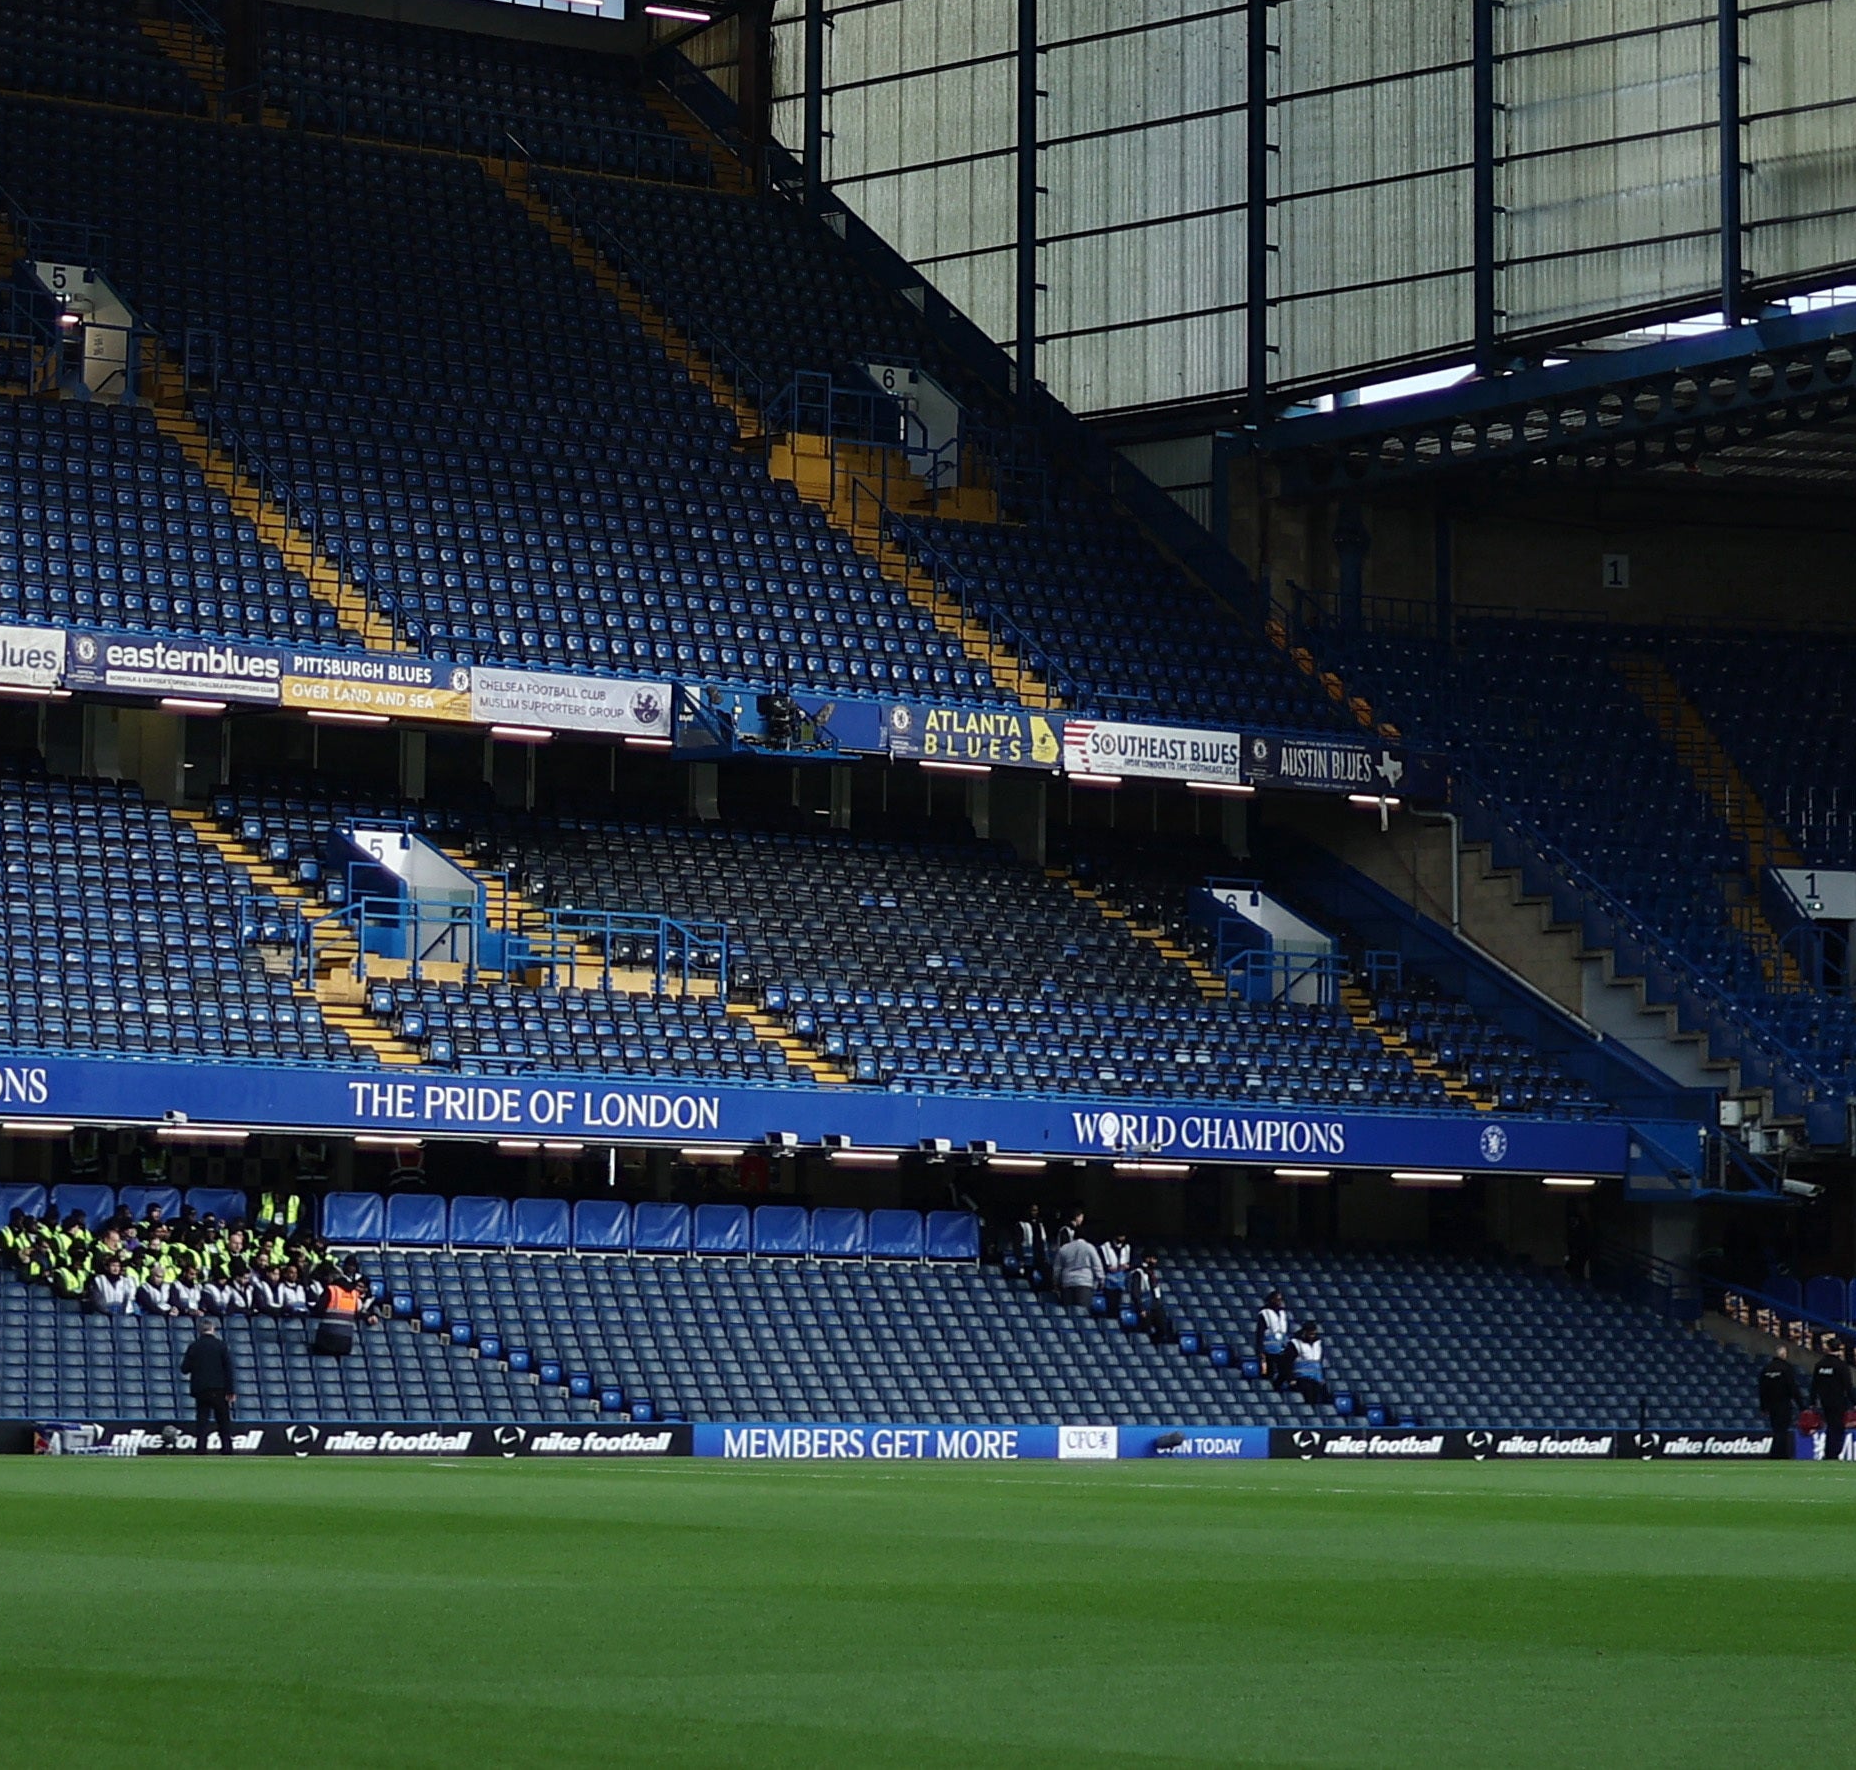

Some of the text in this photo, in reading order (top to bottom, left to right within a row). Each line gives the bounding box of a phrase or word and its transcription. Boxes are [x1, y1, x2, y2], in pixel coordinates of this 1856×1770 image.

[53, 267, 66, 288] 5
[883, 368, 895, 389] 6
[1609, 561, 1623, 585] 1
[106, 641, 280, 678] easternblues
[294, 656, 432, 684] PITTSBURGH BLUES
[292, 683, 329, 700] OVER
[334, 686, 371, 703] LAND
[375, 690, 406, 706] AND
[409, 694, 434, 709] SEA
[479, 679, 607, 700] CHELSEA FOOTBALL CLUB
[479, 696, 519, 709] MUSLIM
[521, 699, 587, 716] SUPPORTERS
[590, 706, 625, 719] GROUP
[925, 709, 1022, 738] ATLANTA
[924, 733, 1022, 762] BLUES
[1091, 732, 1238, 765] SOUTHEAST BLUES
[1142, 759, 1165, 769] LONDON
[1177, 762, 1187, 770] THE
[1280, 746, 1372, 783] AUSTIN BLUES
[370, 838, 383, 860] 5
[1805, 873, 1820, 899] 1
[349, 1081, 720, 1130] THE PRIDE OF LONDON
[1072, 1111, 1345, 1155] WORLD CHAMPIONS
[324, 1430, 473, 1450] nike football
[531, 1431, 673, 1451] nike football
[724, 1429, 1019, 1459] MEMBERS GET MORE
[1066, 1431, 1095, 1449] CFC
[1196, 1438, 1243, 1454] TODAY
[1324, 1435, 1444, 1454] nike football
[1497, 1435, 1613, 1454] nike football
[1663, 1437, 1774, 1454] nike football
